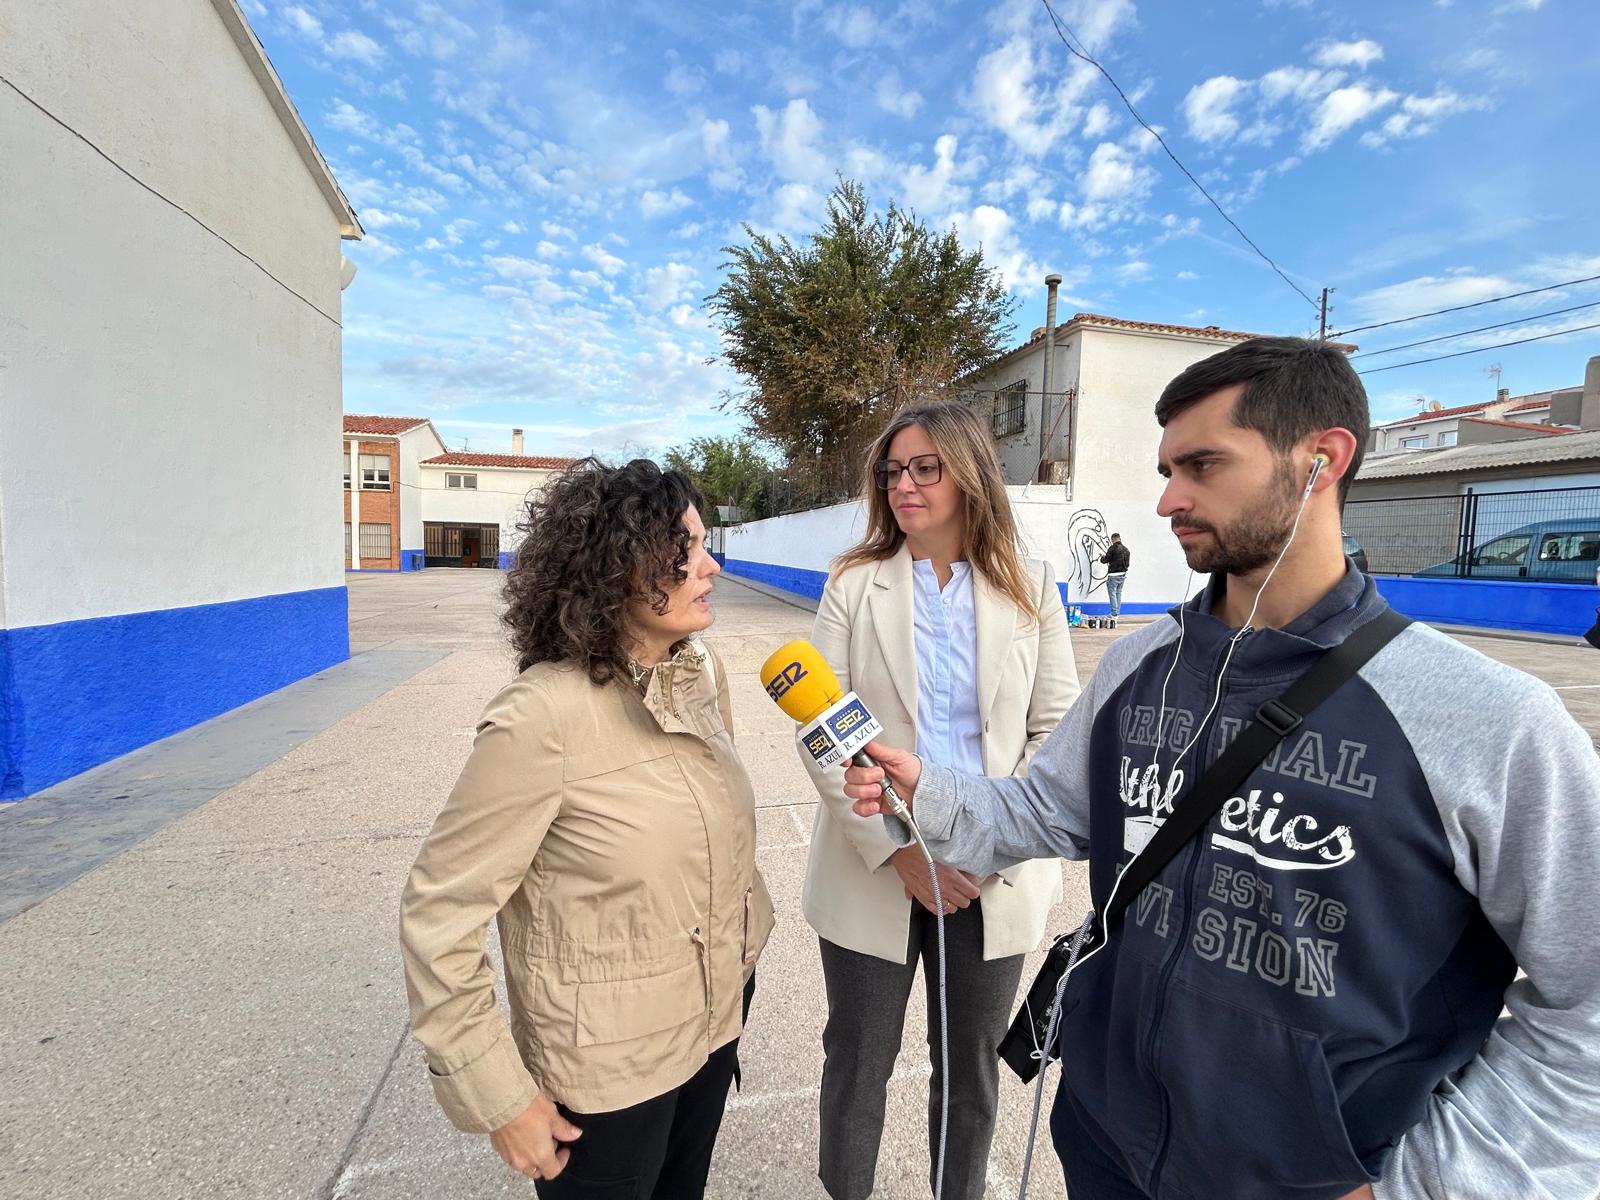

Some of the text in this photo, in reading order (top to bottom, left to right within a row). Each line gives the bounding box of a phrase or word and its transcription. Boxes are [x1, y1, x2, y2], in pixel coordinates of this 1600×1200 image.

[836, 709, 865, 734] SER
[843, 722, 879, 752] R. AZUL
[825, 750, 842, 765] AZUL
[1295, 888, 1347, 934] 76
